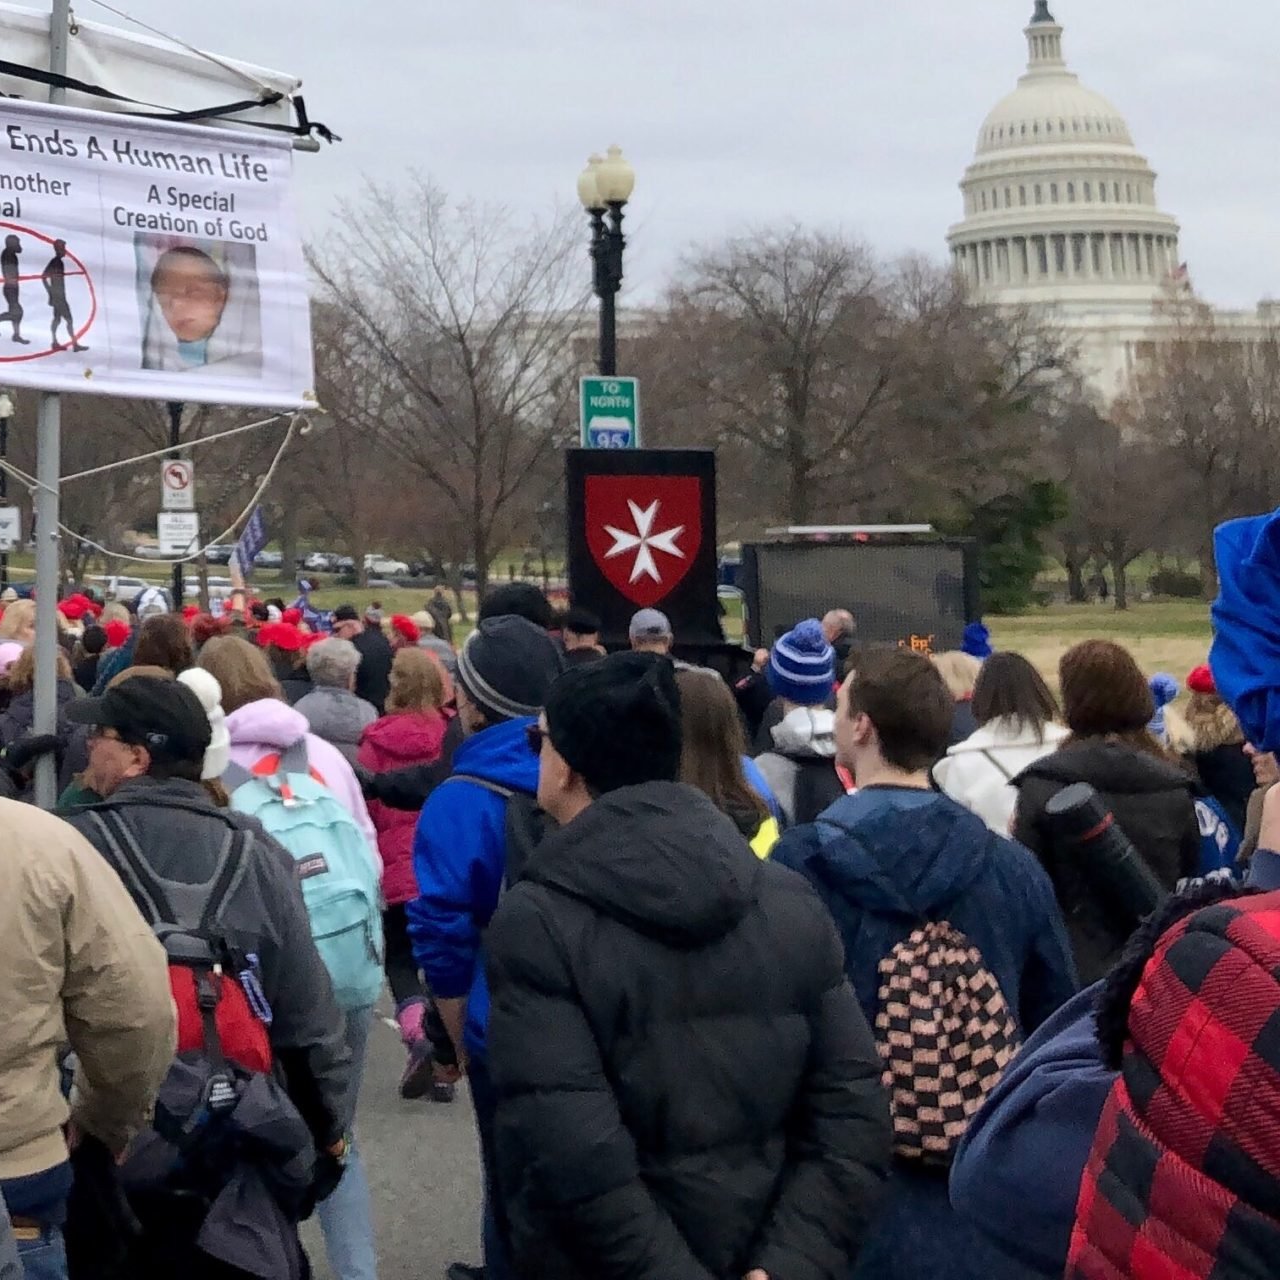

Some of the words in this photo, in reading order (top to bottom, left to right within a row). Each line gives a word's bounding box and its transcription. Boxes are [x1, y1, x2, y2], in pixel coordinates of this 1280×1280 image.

[7, 125, 79, 158] Ends
[87, 136, 108, 162] A
[113, 139, 214, 176] Human
[219, 153, 269, 182] Life
[147, 184, 161, 205] A
[167, 186, 235, 213] Special
[114, 206, 198, 234] Creation
[204, 218, 223, 237] of
[229, 220, 268, 242] God
[600, 381, 620, 394] TO
[590, 395, 631, 408] NORTH
[597, 432, 627, 449] 95
